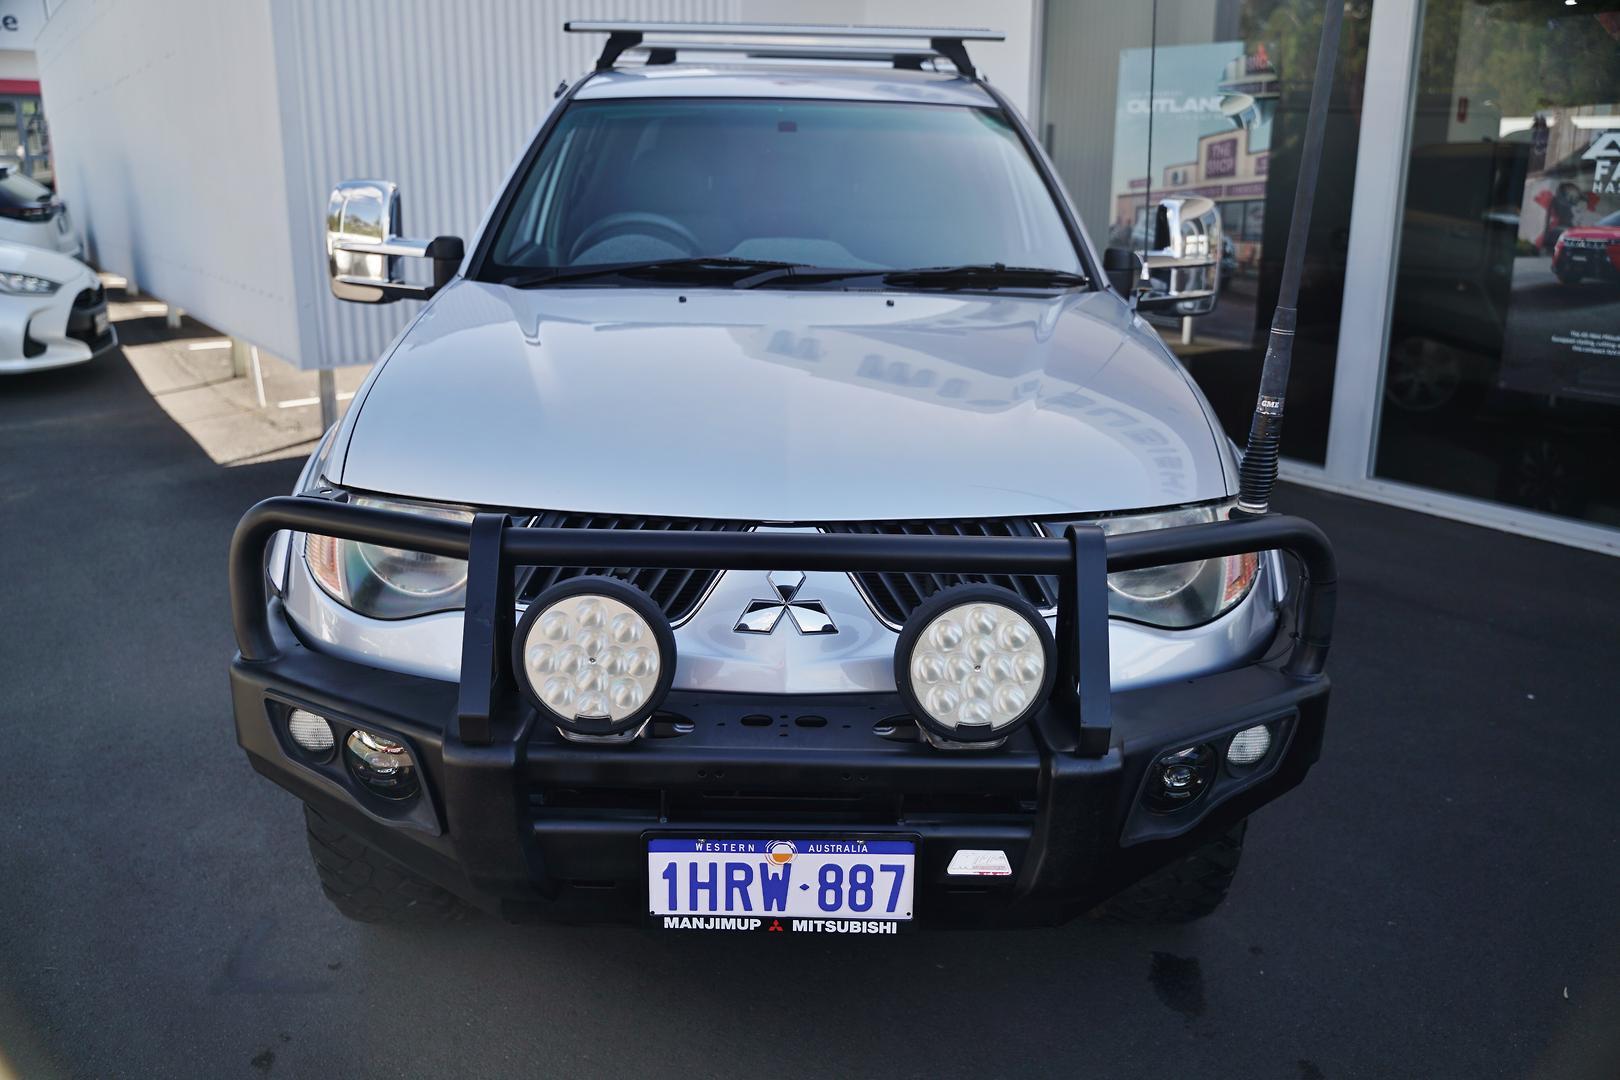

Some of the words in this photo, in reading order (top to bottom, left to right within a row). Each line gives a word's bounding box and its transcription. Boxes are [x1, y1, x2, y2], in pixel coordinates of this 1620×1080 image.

[695, 842, 756, 853] WESTERN
[808, 843, 869, 853] AUSTRALIA
[663, 917, 762, 931] MANJIMUP
[792, 919, 897, 934] MITSUBISHI
